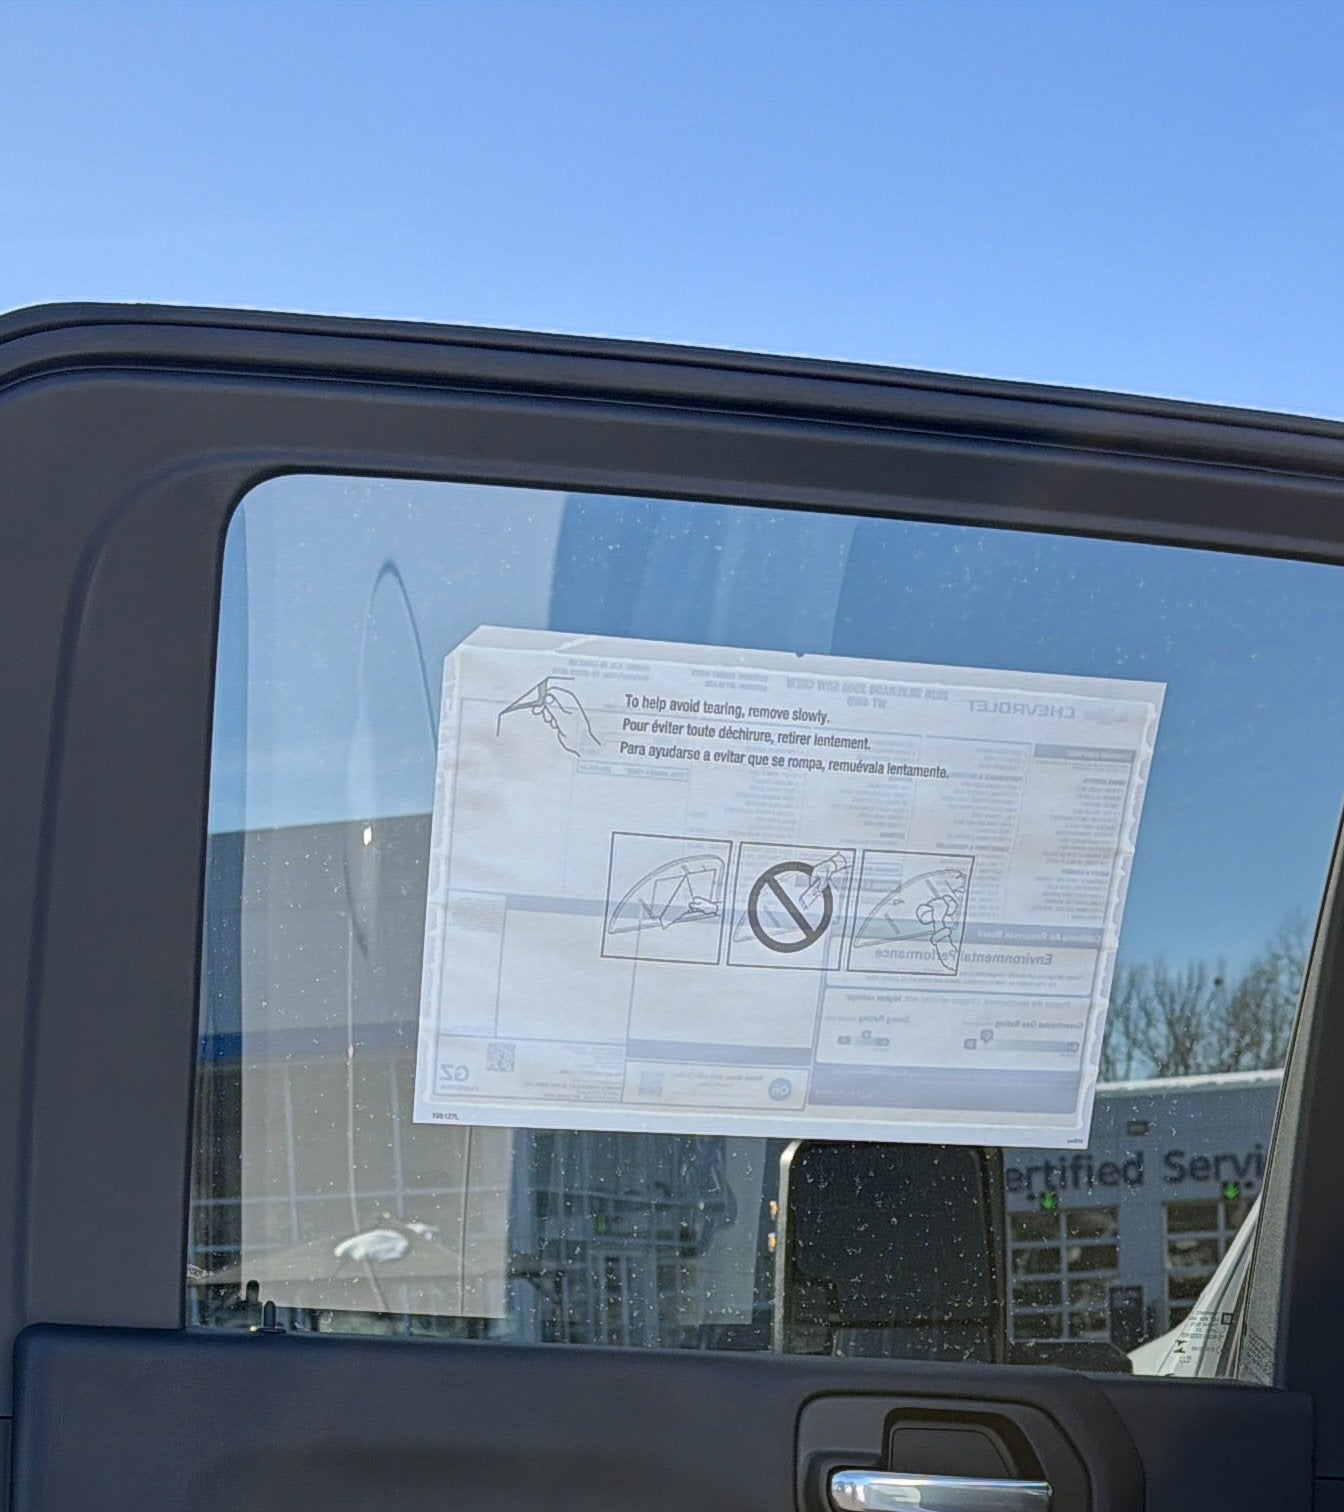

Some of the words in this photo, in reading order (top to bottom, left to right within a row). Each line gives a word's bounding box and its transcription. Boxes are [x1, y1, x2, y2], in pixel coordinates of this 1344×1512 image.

[625, 693, 639, 709] To
[642, 695, 667, 712] help
[669, 698, 700, 713] avoid
[703, 701, 746, 720] tearing,
[748, 705, 790, 720] remove
[792, 707, 830, 726] slowly.
[622, 717, 650, 733] Pour
[651, 719, 685, 736] éviter
[687, 723, 716, 738] toute
[718, 725, 775, 745] déchirure,
[777, 730, 813, 747] retirer
[814, 733, 872, 751] lentement.
[619, 740, 646, 756] Para
[648, 744, 701, 761] ayudarse
[703, 748, 711, 761] a
[713, 749, 746, 764] evitar
[748, 753, 769, 768] que
[771, 755, 785, 768] se
[787, 757, 826, 773] rompa,
[828, 758, 885, 776] remuévala
[887, 761, 950, 780] lentamente.
[1005, 1152, 1145, 1194] ertified
